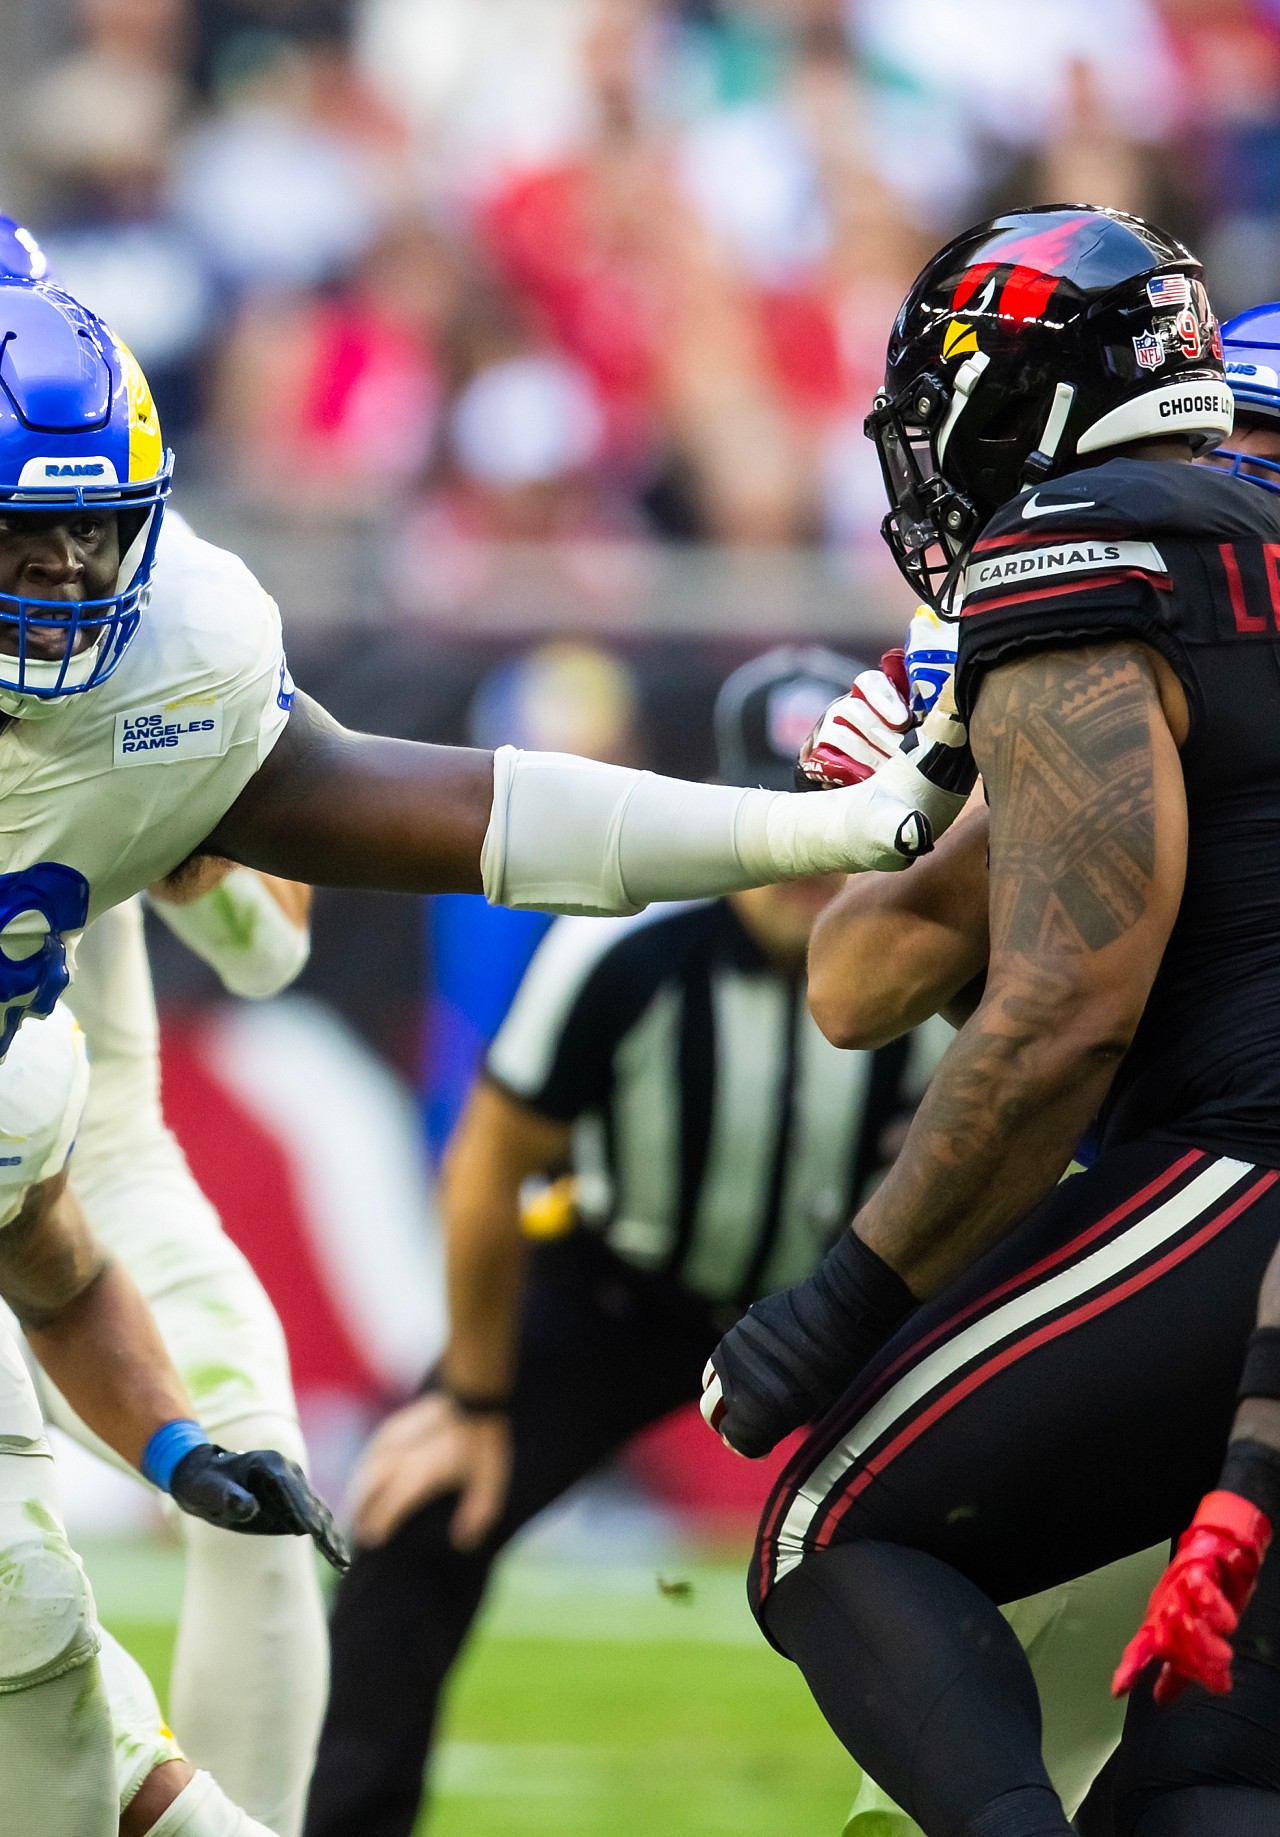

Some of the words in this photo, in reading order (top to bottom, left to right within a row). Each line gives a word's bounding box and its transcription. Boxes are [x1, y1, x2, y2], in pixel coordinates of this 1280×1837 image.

[1140, 346, 1161, 365] NFL
[1159, 396, 1218, 418] CHOOSE
[45, 464, 105, 477] RAMS
[979, 546, 1120, 583] CARDINALS
[122, 719, 215, 742] ANGELES
[124, 714, 163, 730] LOS
[122, 735, 179, 754] RAMS
